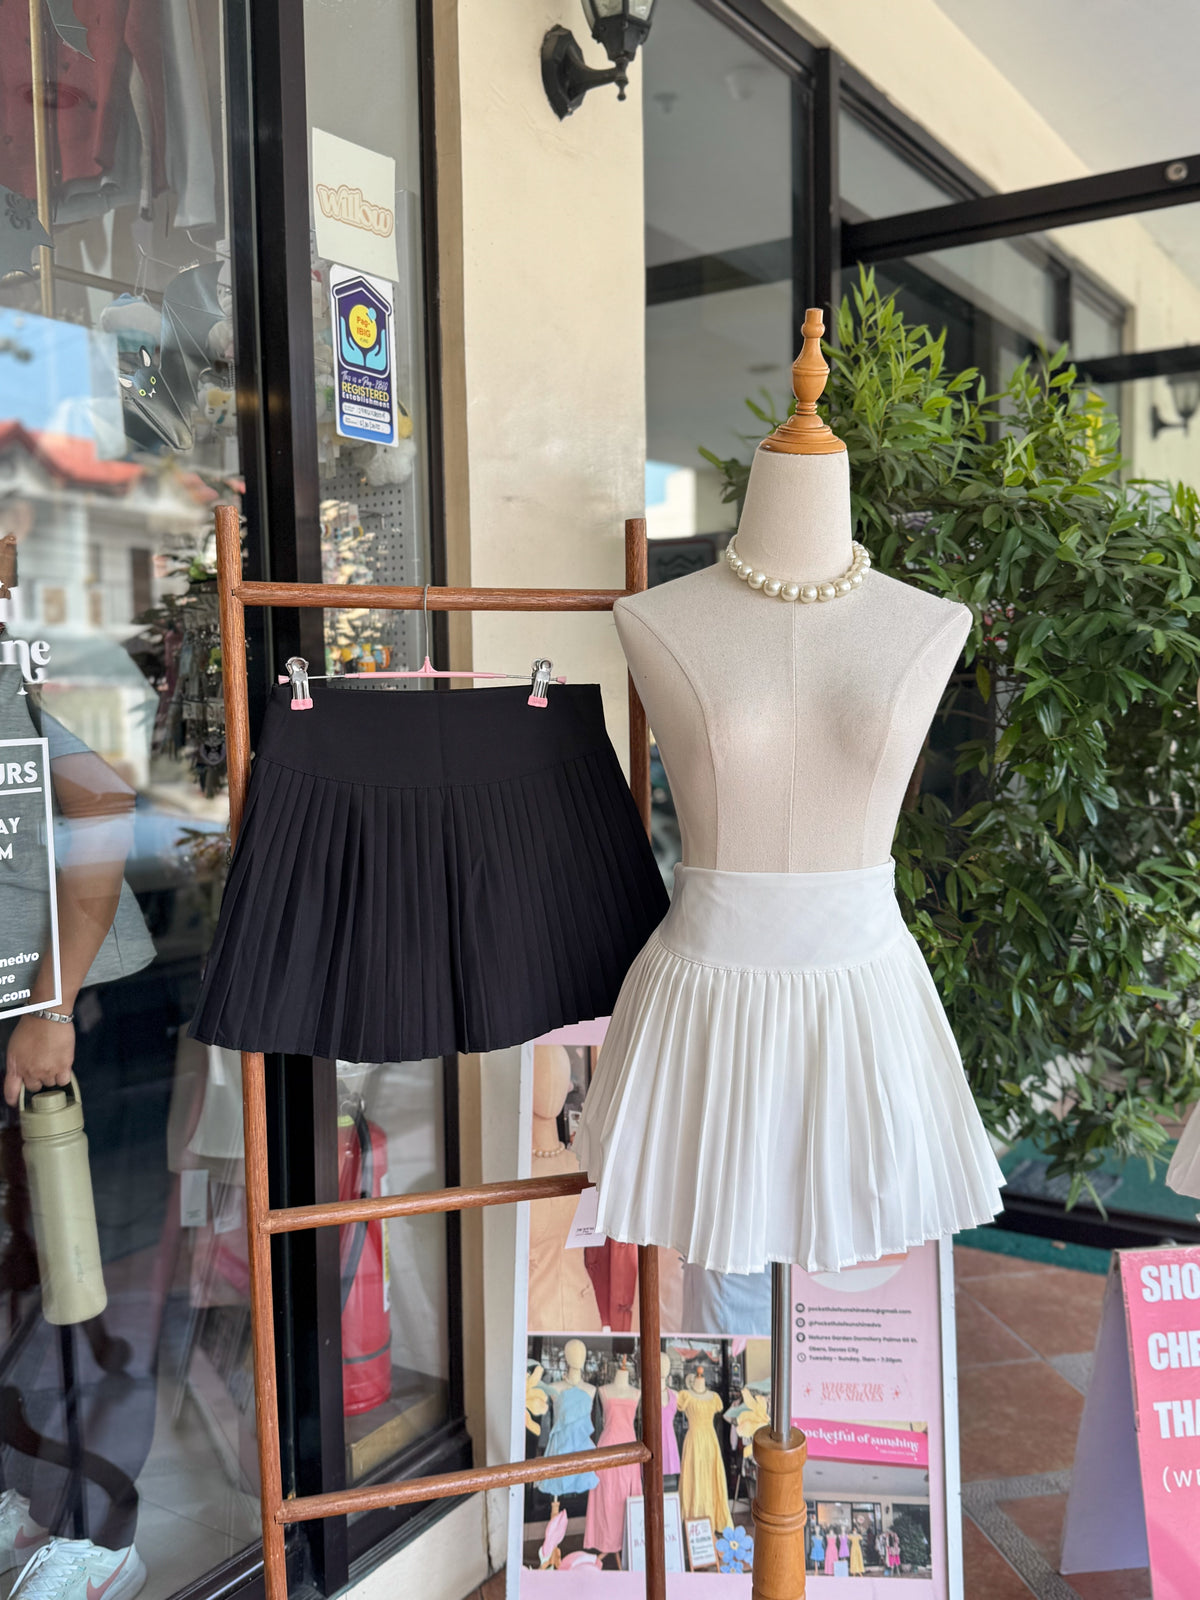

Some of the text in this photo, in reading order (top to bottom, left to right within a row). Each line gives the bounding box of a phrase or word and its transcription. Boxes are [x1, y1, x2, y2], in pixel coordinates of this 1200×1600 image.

[356, 315, 370, 328] Pag-
[356, 327, 371, 338] IBIG
[341, 382, 389, 402] REGISTERED
[341, 392, 389, 409] Establishment
[821, 1382, 884, 1393] WHERE THE
[821, 1391, 884, 1402] SUN SHINES
[856, 1433, 870, 1444] of
